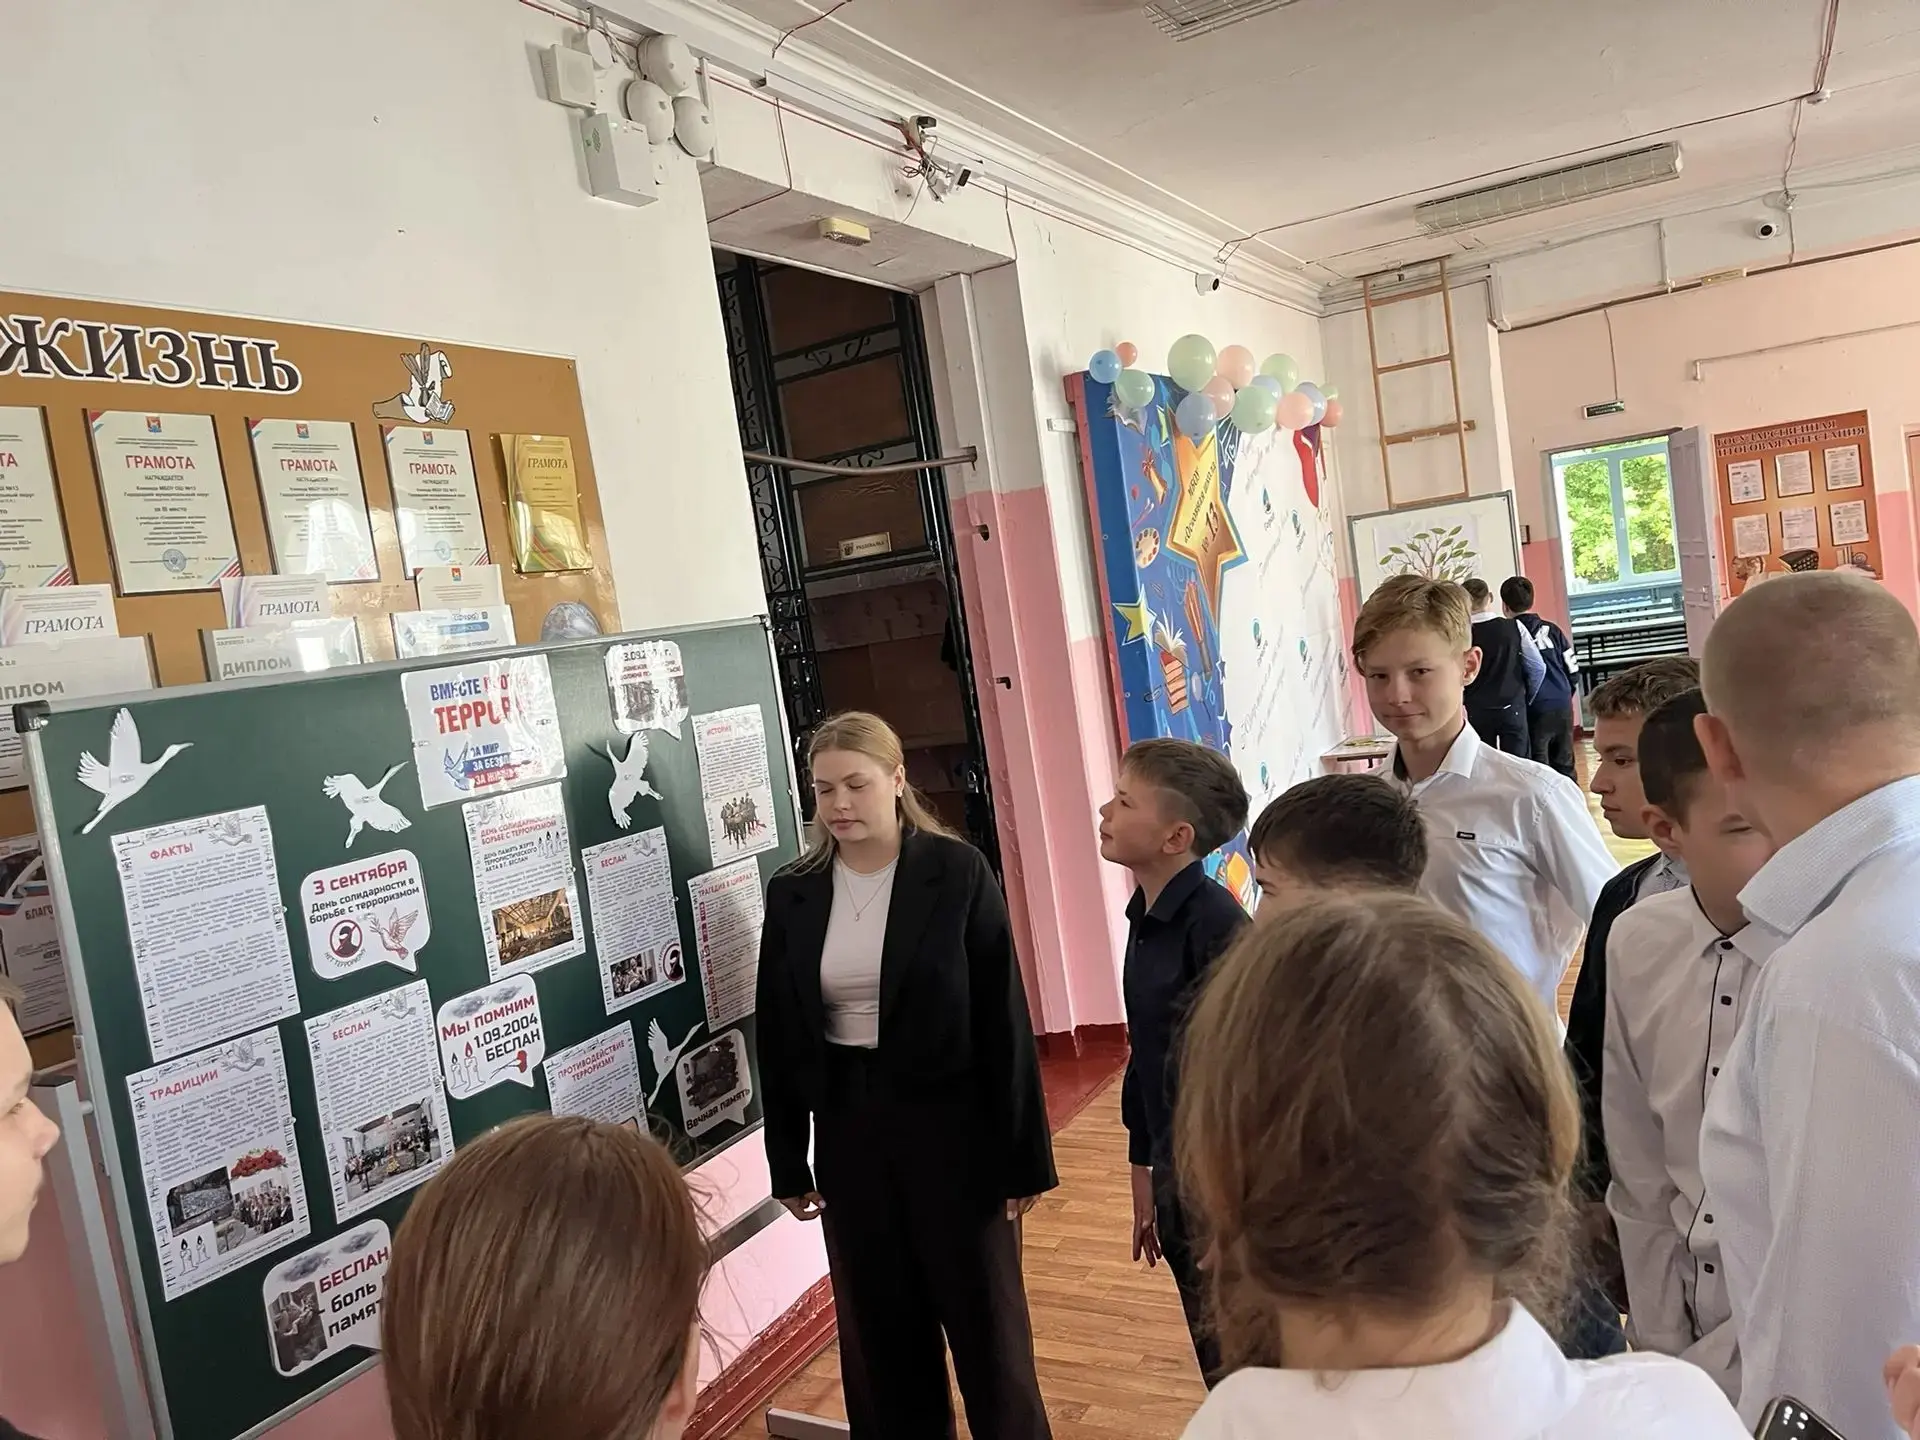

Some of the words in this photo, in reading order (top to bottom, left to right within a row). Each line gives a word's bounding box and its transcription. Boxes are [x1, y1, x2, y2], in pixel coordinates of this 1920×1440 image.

[0, 317, 300, 393] ЖИЗНЬ
[125, 455, 196, 470] ГРАМОТА
[280, 459, 338, 472] ГРАМОТА
[409, 462, 457, 476] ГРАМОТА
[527, 457, 568, 469] ГРАМОТА
[1206, 501, 1219, 542] 13
[259, 601, 320, 616] ГРАМОТА
[24, 615, 104, 635] ГРАМОТА
[222, 656, 292, 678] ДИПЛОМ
[482, 742, 500, 755] МИР
[472, 760, 484, 772] ЗА
[474, 772, 486, 785] ЗА
[482, 836, 504, 845] БОРЬБЕ
[511, 820, 557, 836] ТЕРРОРИЗМОМ
[150, 843, 194, 860] ФАКТЫ
[600, 854, 628, 868] БЕСЛАН
[313, 879, 325, 895] 3
[330, 860, 408, 891] сентября
[309, 908, 346, 924] борьбе
[348, 905, 354, 913] с
[355, 887, 419, 913] терроризмом
[311, 901, 338, 914] День
[339, 879, 406, 905] солидарности
[332, 1020, 372, 1041] БЕСЛАН
[442, 1021, 470, 1042] Мы
[474, 995, 535, 1029] помним
[473, 1012, 539, 1049] 1.09.2004
[486, 1028, 541, 1063] БЕСЛАН
[557, 1039, 625, 1079] ПРОТИВОДЕЙСТВИЕ
[572, 1056, 616, 1082] ТЕРРОРИЗМУ
[149, 1069, 218, 1101] ТРАДИЦИИ
[686, 1105, 718, 1131] Вечная
[720, 1088, 751, 1111] память
[319, 1246, 389, 1293] БЕСЛАН
[331, 1283, 377, 1313] боль
